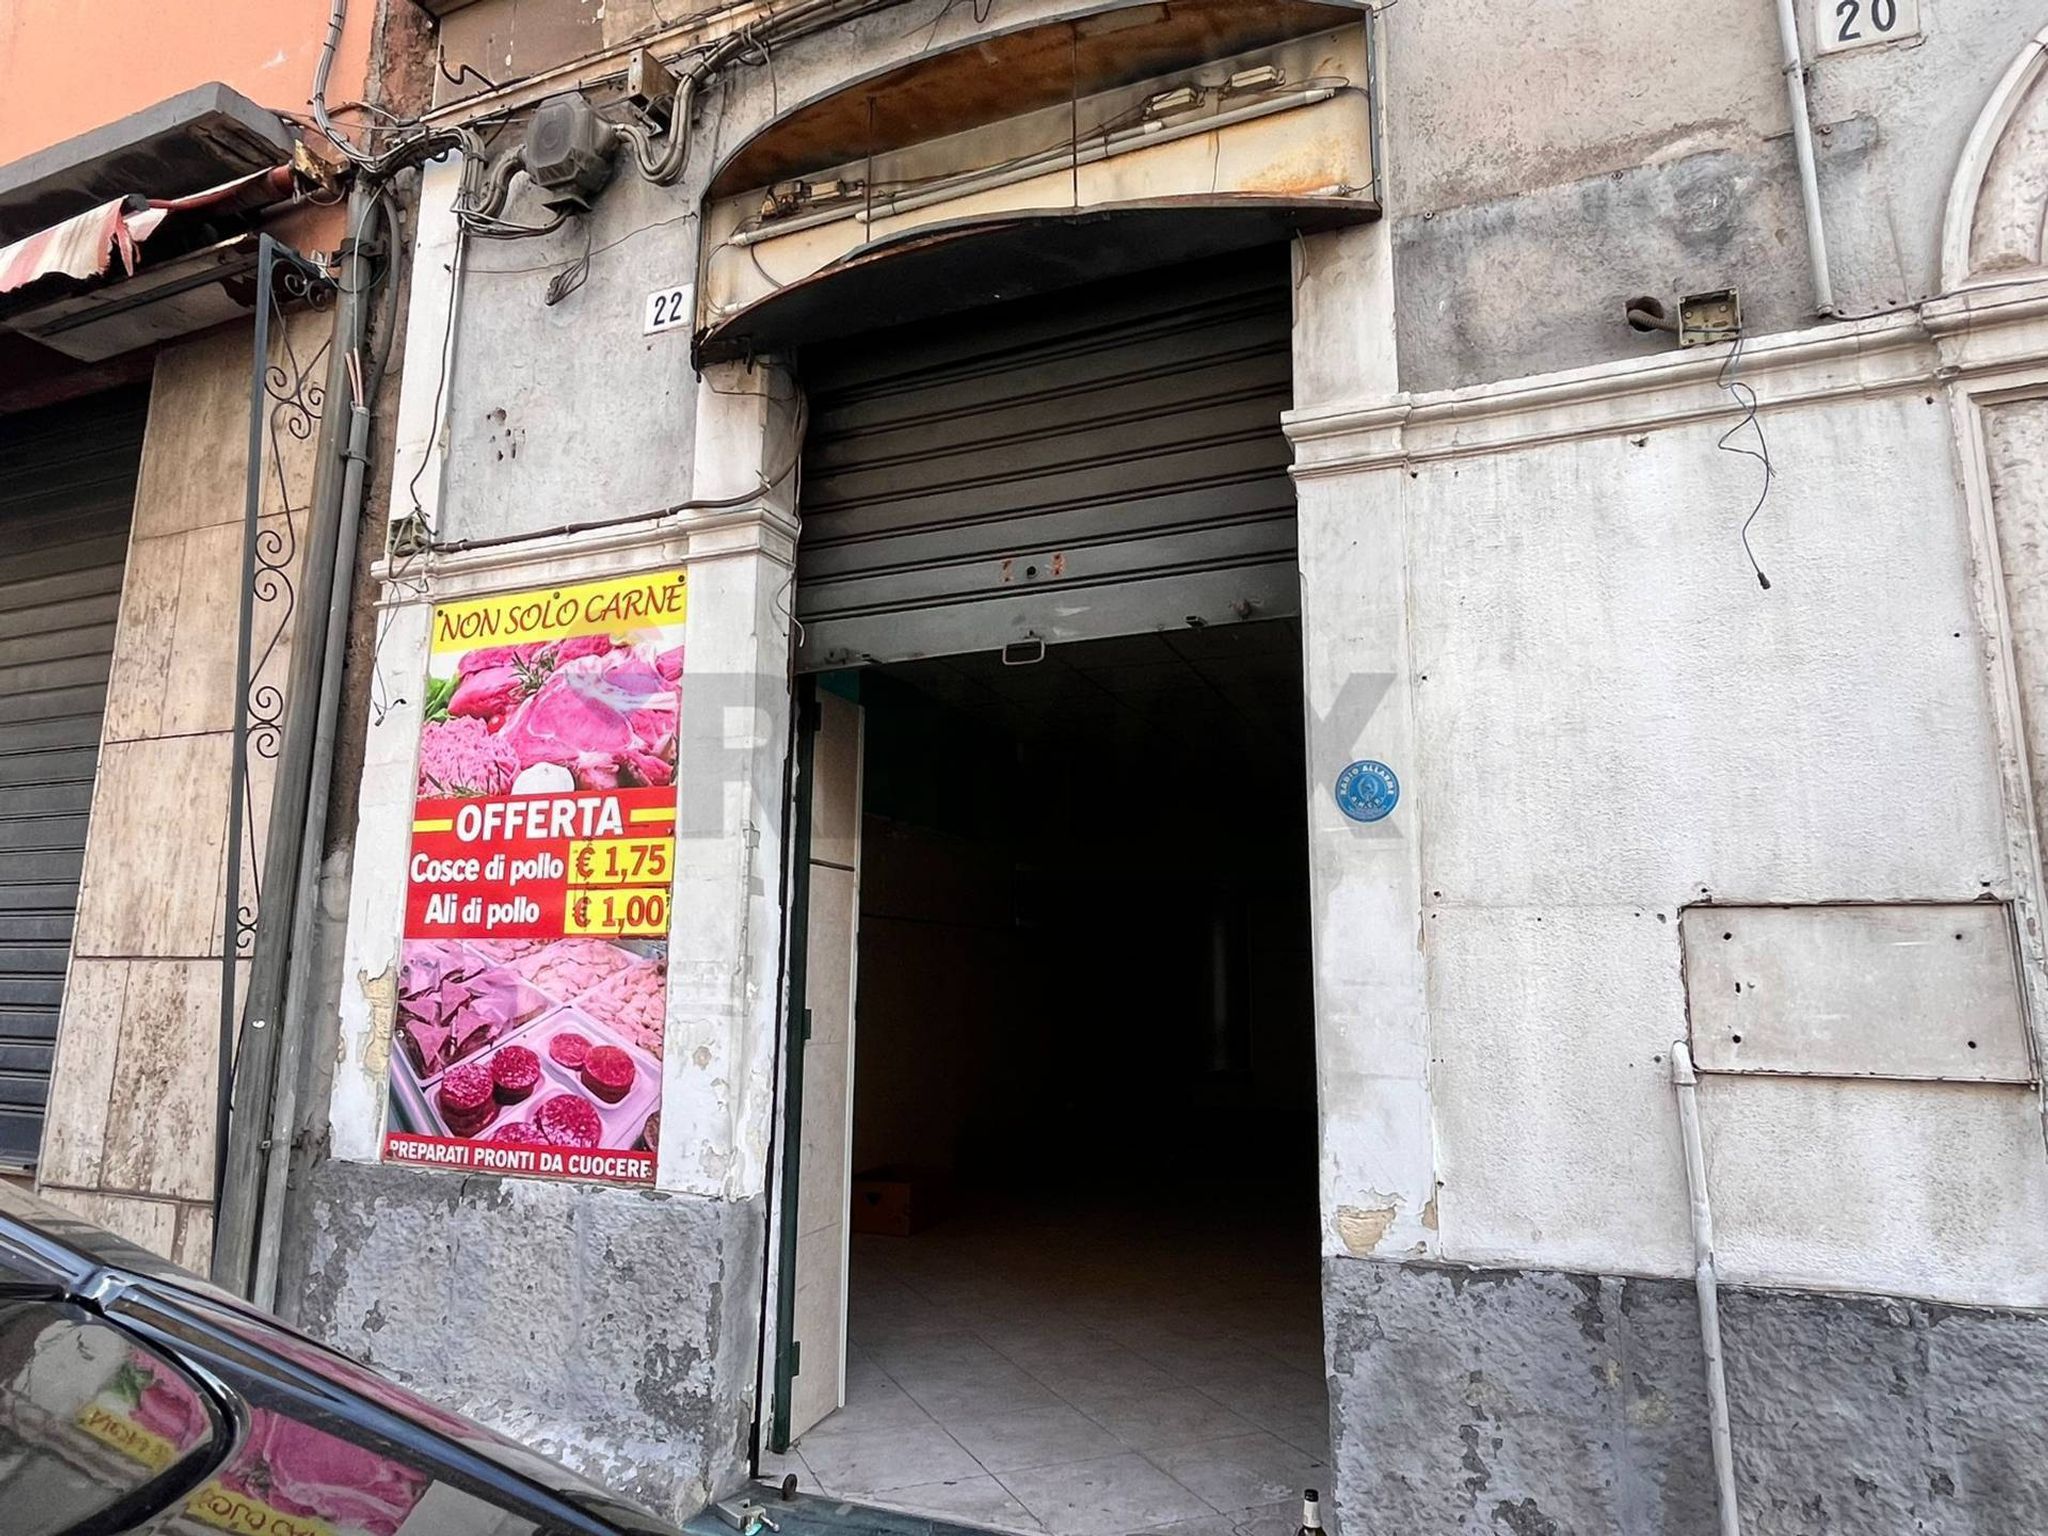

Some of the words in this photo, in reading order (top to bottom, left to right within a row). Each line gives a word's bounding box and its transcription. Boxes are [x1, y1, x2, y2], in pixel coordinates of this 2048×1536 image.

[1836, 0, 1896, 42] 20
[654, 291, 683, 326] 22
[440, 608, 501, 642] NON
[504, 598, 579, 635] SOLO
[585, 583, 686, 625] CARNE
[456, 797, 624, 843] OFFERTA
[411, 852, 480, 884] Cosce
[485, 851, 505, 880] di
[510, 852, 564, 887] pollo
[604, 845, 667, 881] 1,75
[424, 893, 457, 925] Ali
[461, 897, 482, 924] di
[486, 896, 540, 931] pollo
[602, 896, 664, 931] 1,00
[389, 1139, 469, 1164] PREPARATI
[474, 1149, 536, 1171] PRONTI
[540, 1153, 563, 1174] DA
[568, 1155, 652, 1179] CUOCERE
